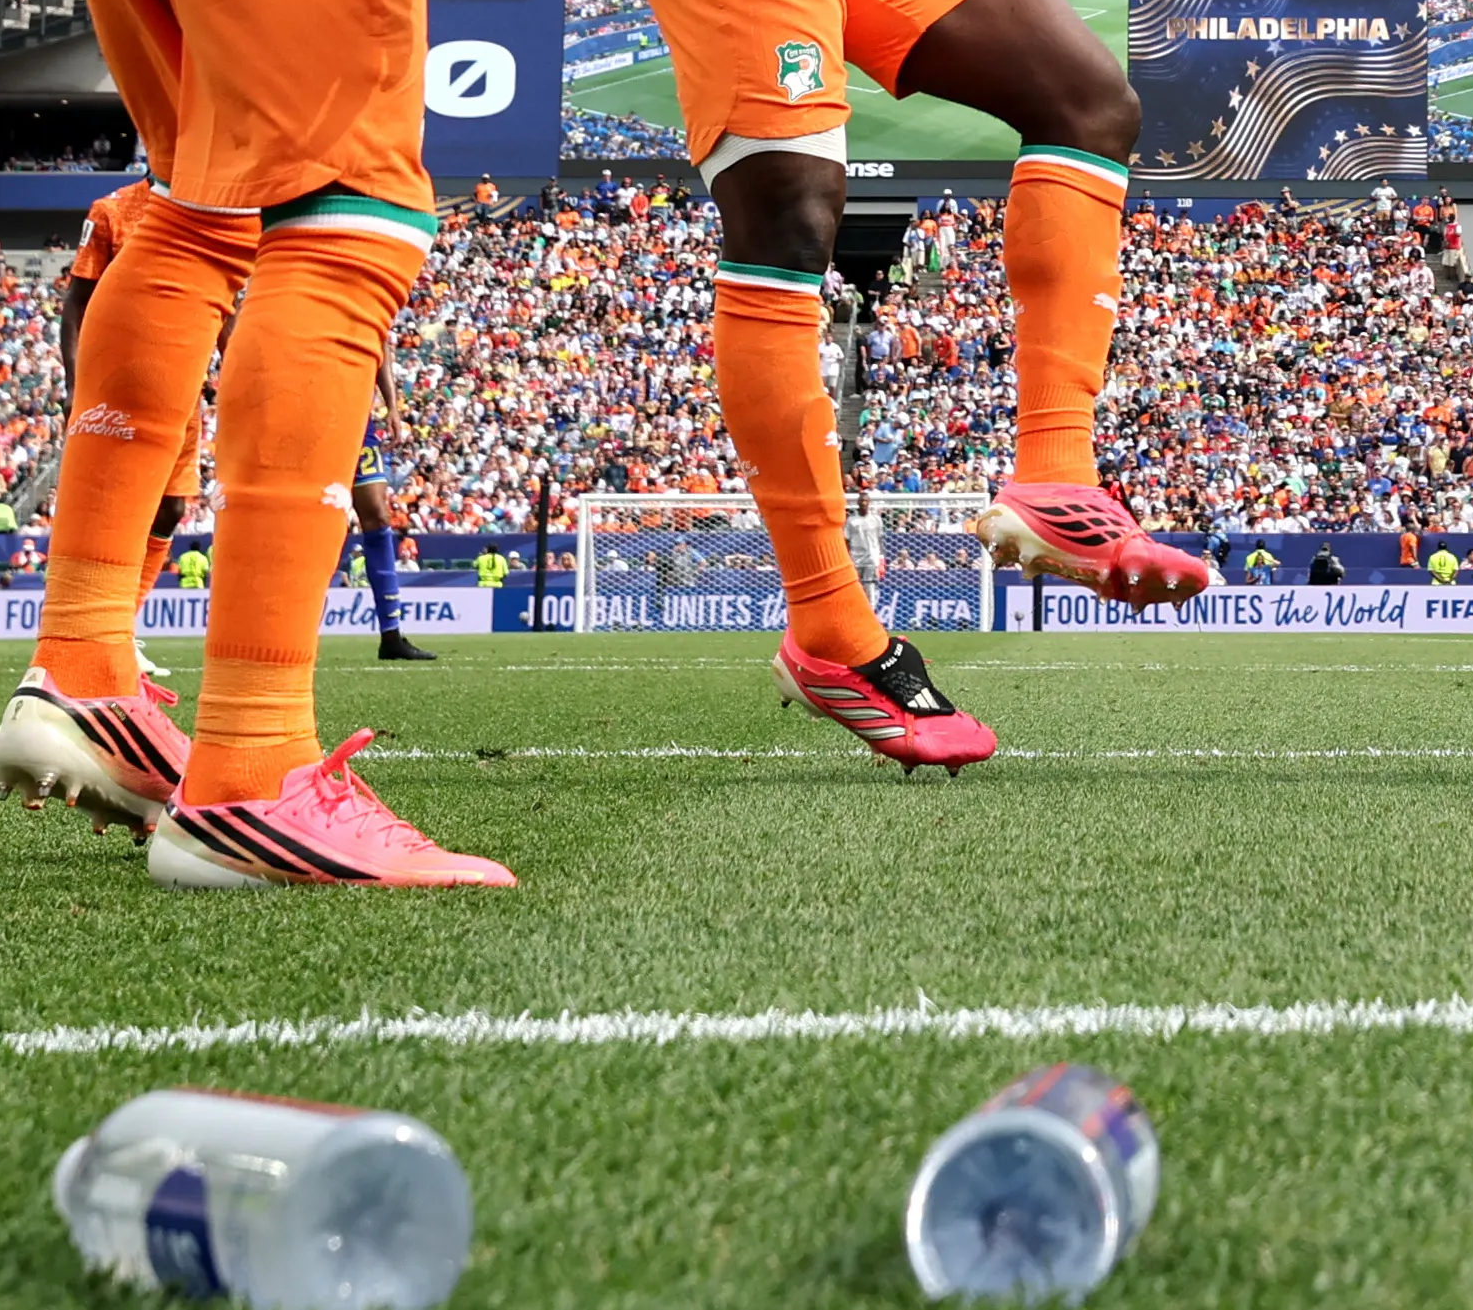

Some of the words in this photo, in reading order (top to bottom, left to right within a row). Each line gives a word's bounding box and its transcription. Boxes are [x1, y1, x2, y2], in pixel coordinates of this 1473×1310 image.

[1167, 17, 1390, 41] PHILADELPHIA
[423, 39, 517, 118] 0
[359, 445, 384, 475] 21
[142, 597, 210, 629] UNIT
[399, 601, 456, 622] FIFA
[527, 595, 659, 628] OOBALL
[663, 594, 750, 628] UNITES
[916, 600, 972, 621] FIFA
[1176, 594, 1264, 625] UNITES
[1270, 589, 1319, 629] the
[1325, 589, 1409, 630] World
